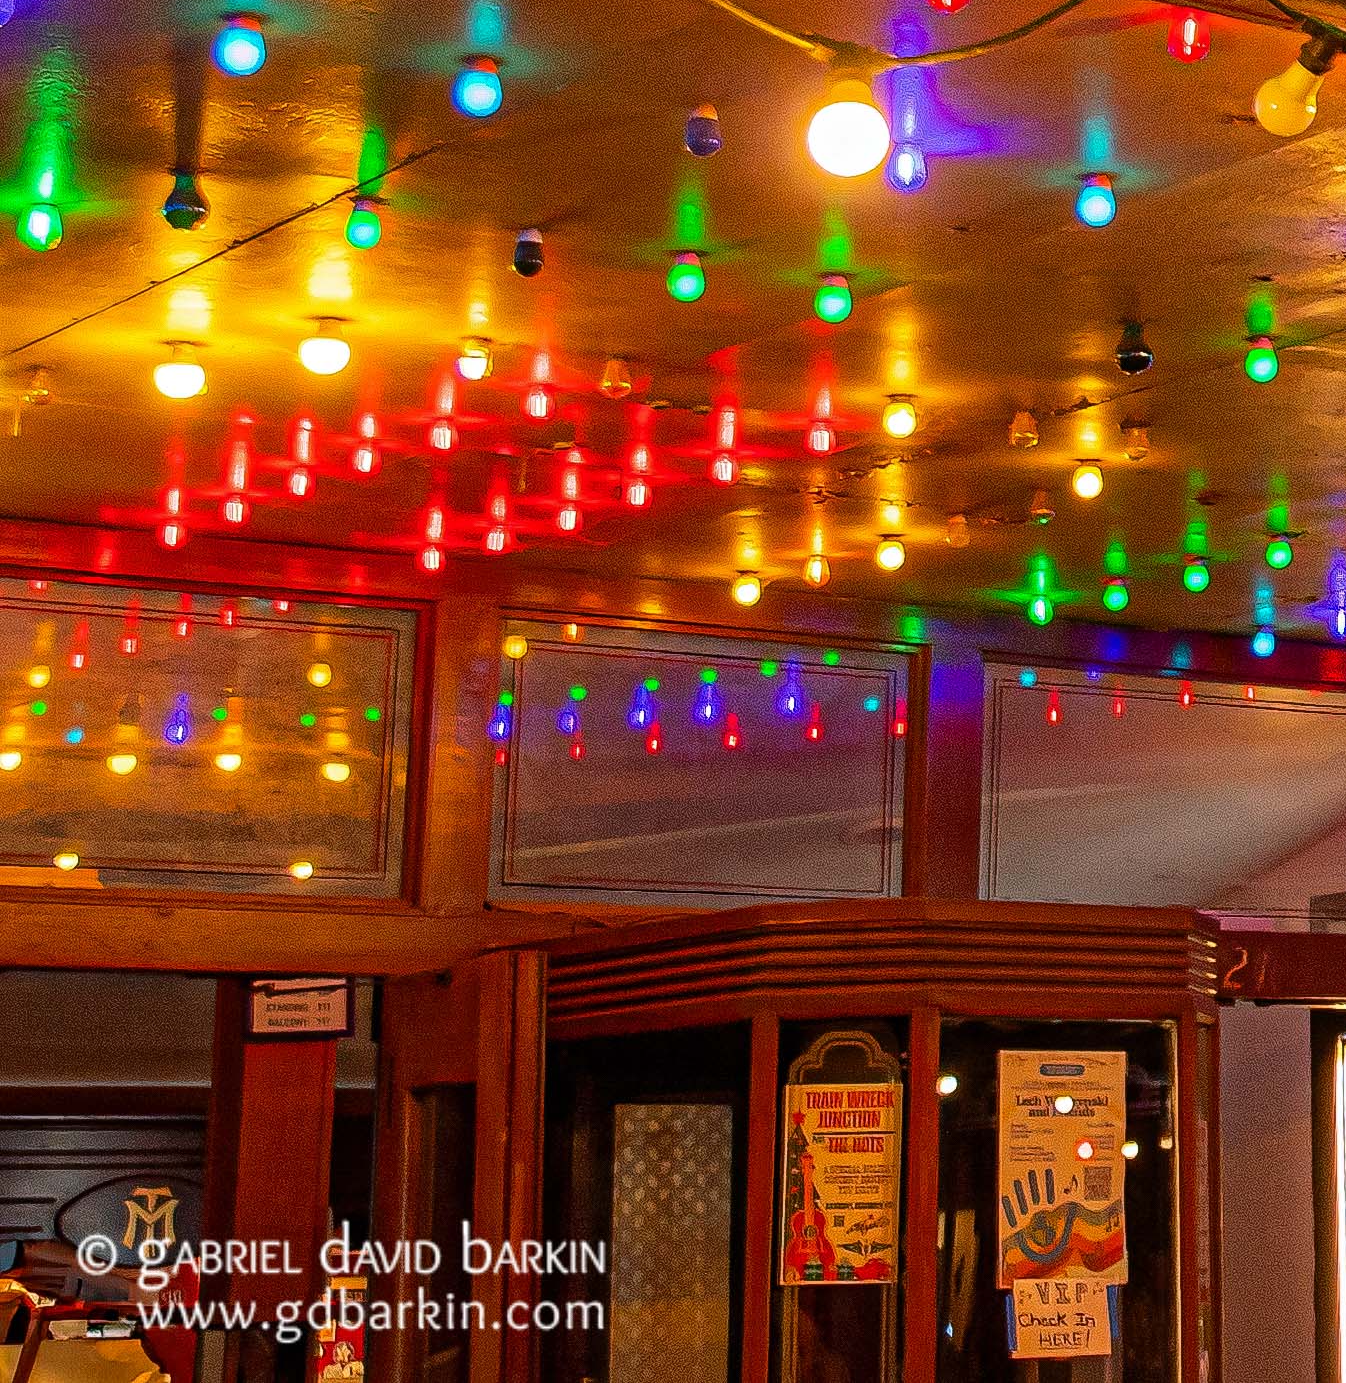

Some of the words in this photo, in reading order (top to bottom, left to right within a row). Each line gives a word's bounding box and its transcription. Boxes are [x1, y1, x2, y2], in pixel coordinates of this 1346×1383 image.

[806, 1091, 843, 1109] TRAIN
[847, 1090, 895, 1108] WRECK
[817, 1110, 881, 1128] JUNCTION
[1035, 1281, 1089, 1305] VIP
[1018, 1311, 1068, 1328] Check
[1073, 1312, 1096, 1328] In
